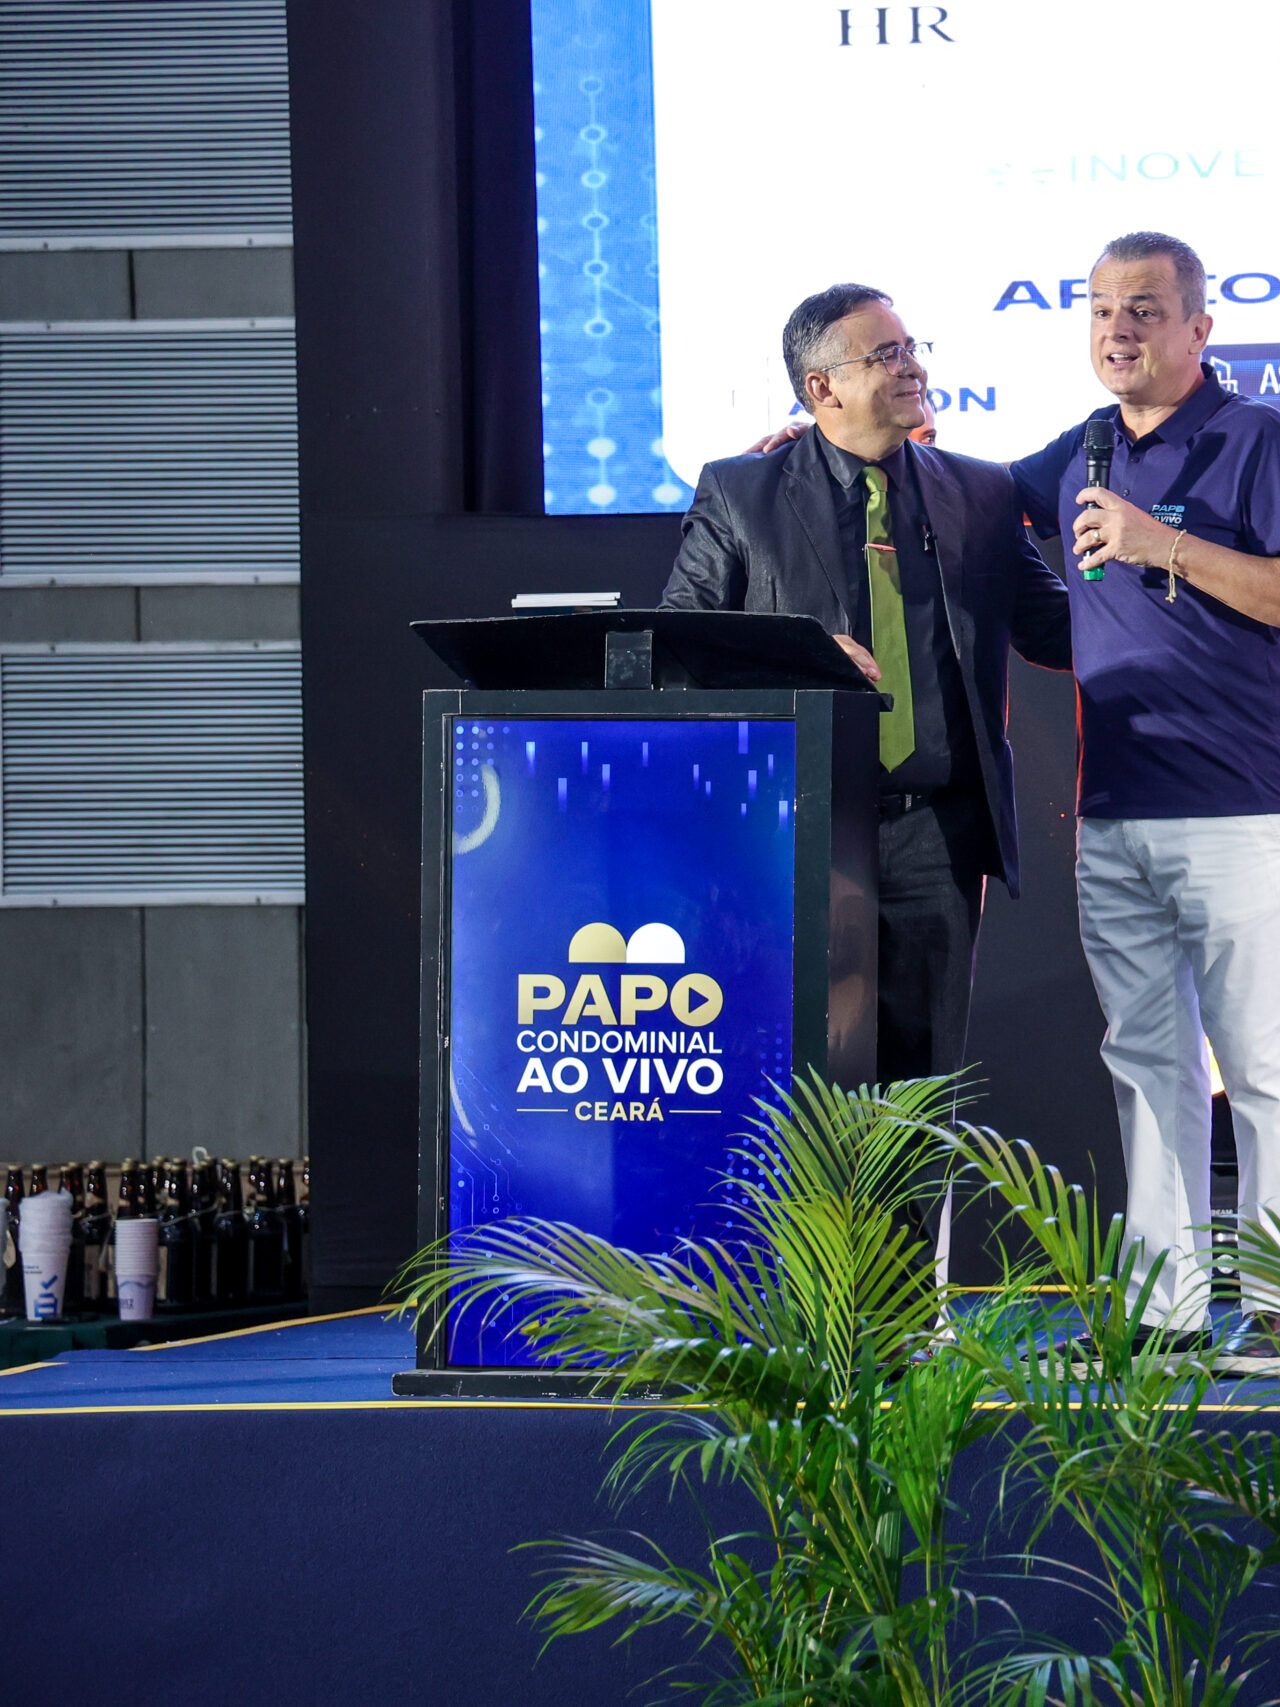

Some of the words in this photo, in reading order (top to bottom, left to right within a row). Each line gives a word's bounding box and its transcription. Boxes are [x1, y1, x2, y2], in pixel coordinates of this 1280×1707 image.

[837, 5, 956, 46] HR
[517, 972, 724, 1027] PAPO
[516, 1030, 723, 1054] CONDOMINIAL
[516, 1057, 589, 1094] AO
[602, 1057, 724, 1095] VIVO
[574, 1097, 664, 1122] CEARÁ
